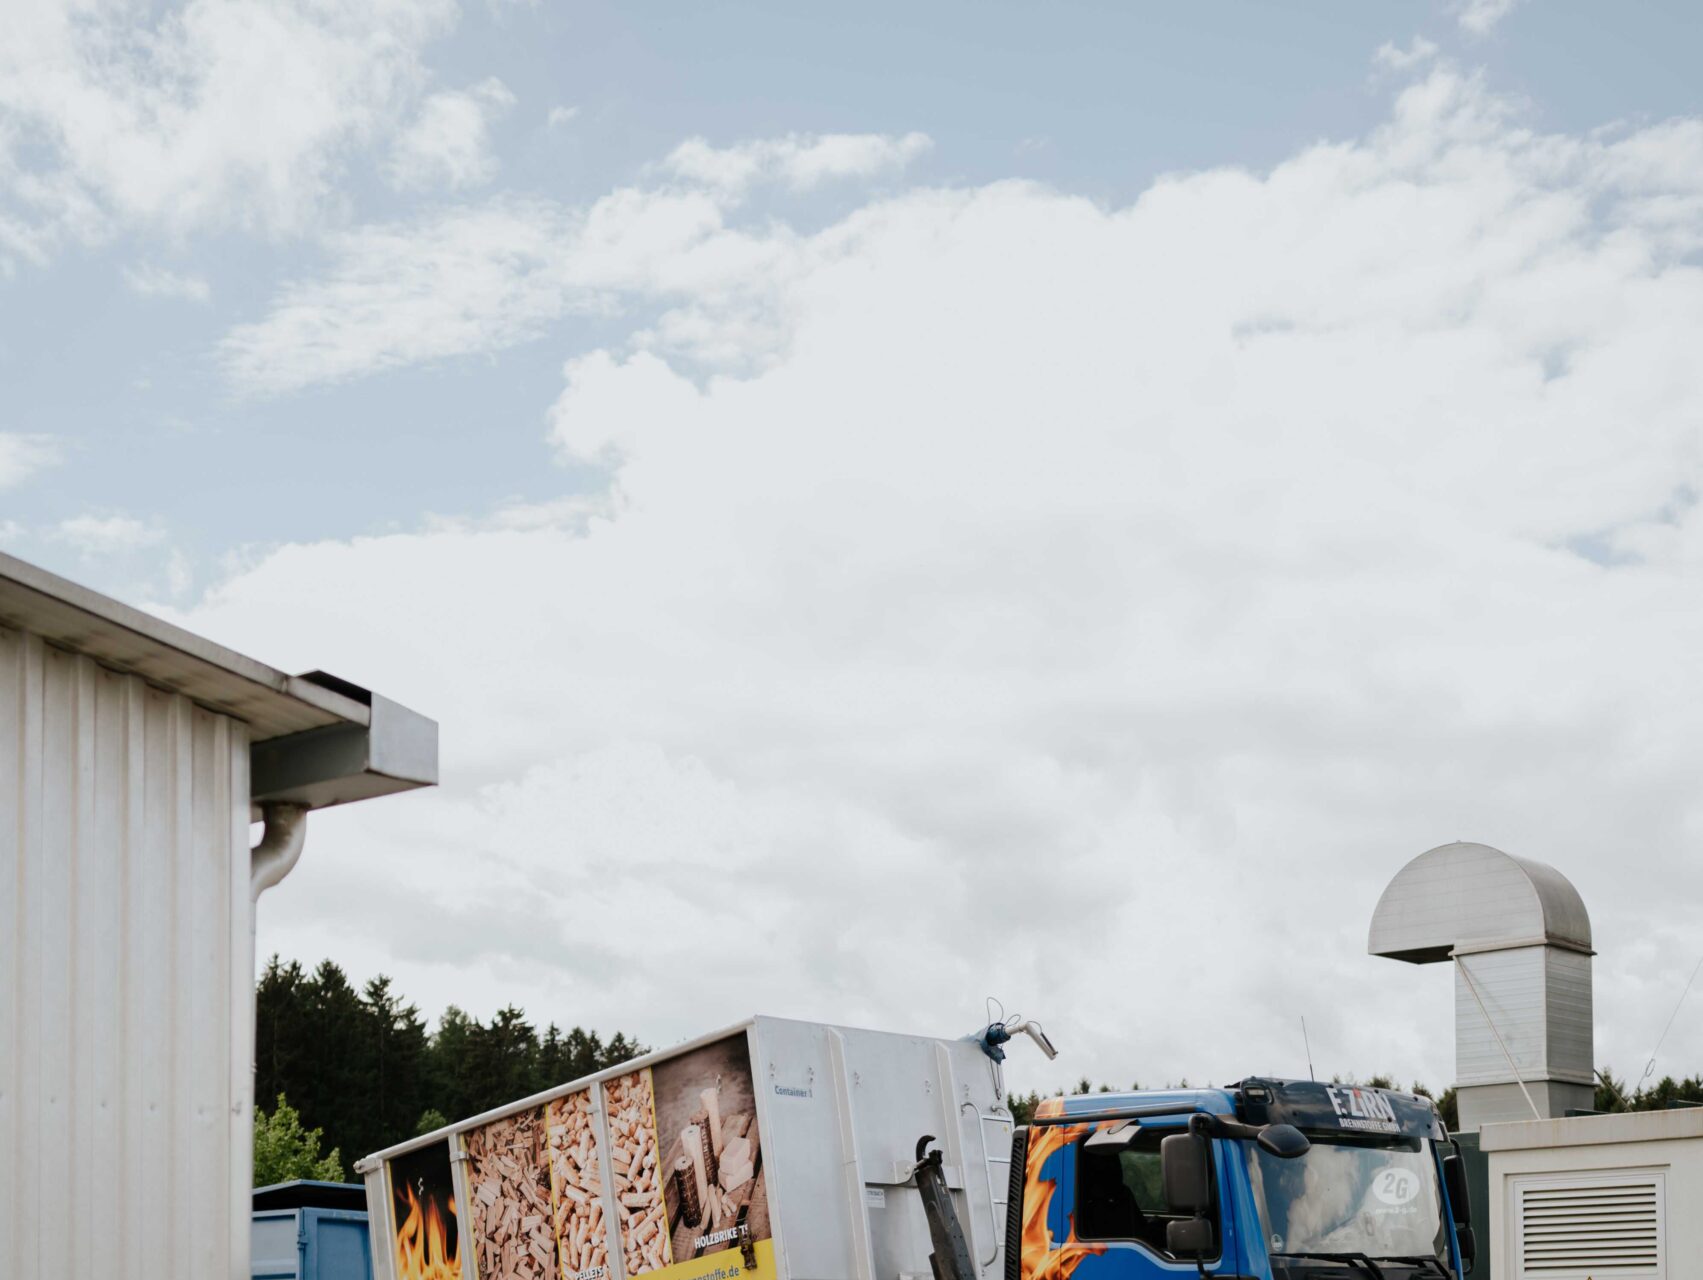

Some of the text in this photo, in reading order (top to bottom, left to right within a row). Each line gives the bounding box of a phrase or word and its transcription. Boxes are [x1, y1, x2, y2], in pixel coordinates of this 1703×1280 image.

[1325, 1087, 1348, 1116] F.
[1338, 1117, 1382, 1131] BRENNSTOFFE
[694, 1223, 749, 1249] HOLZBRIKET
